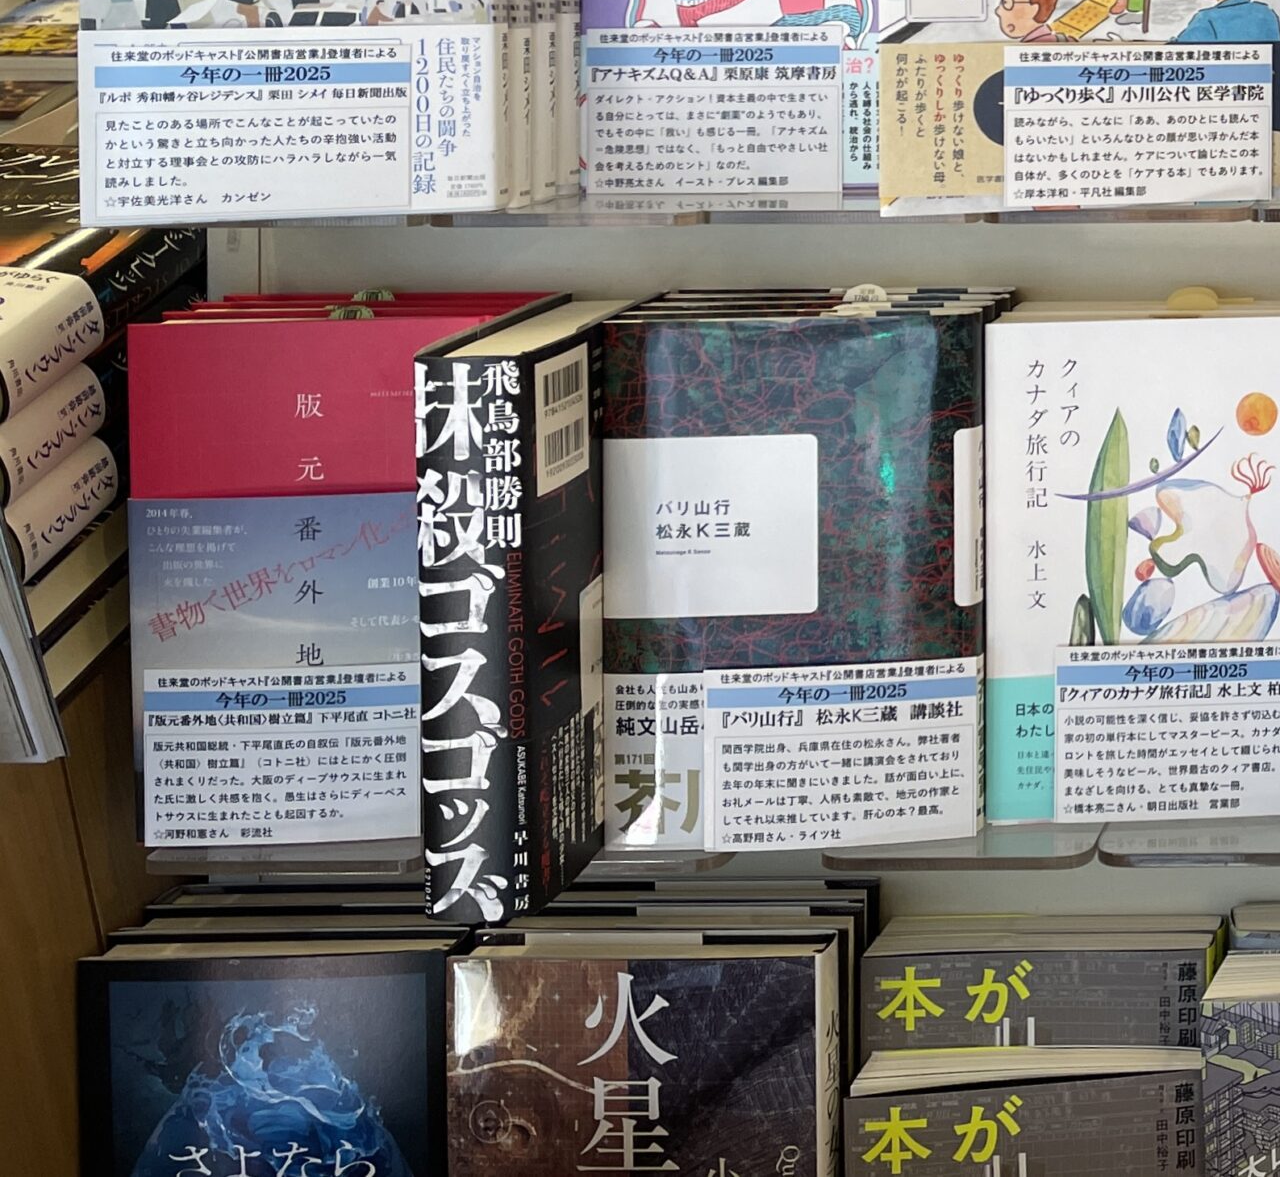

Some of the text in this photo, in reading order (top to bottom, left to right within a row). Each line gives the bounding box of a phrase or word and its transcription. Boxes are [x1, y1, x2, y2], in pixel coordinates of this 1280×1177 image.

[653, 48, 773, 63] 今年の一冊2025
[180, 66, 331, 84] 今年の一冊2025
[1078, 67, 1205, 84] 今年の一冊2025
[436, 38, 457, 157] 住民たちの闘争
[896, 53, 909, 136] 何かが起こる！
[914, 53, 927, 138] ふたりが歩くと
[1014, 85, 1264, 105] 『ゆっくり歩く』 小川公代 医学書院
[105, 114, 397, 131] 見たことのある場所でこんなことが起こっていたの
[933, 53, 946, 188] ゆっくりしか歩けない母。
[952, 53, 965, 178] ゆっくり歩けない娘と、
[1014, 113, 1259, 129] 読みながら、こんなに「ああ、あのひとにも読んで
[105, 133, 397, 150] かという驚きと立ち向かった人たちの辛抱強い活動
[1014, 131, 1259, 146] もらいたい」といろんなひとの顔が思い浮かんだ本
[105, 151, 397, 169] と対立する理事会との攻防にハラハラしながら一気
[1014, 149, 1259, 164] はないかもしれません。ケアについて論じたこの本
[105, 177, 188, 188] 読みしました。
[1014, 166, 1264, 181] 自体が、多くのひとを「ケアする本」でもあります。
[1026, 359, 1048, 509] カナダ旅行記
[480, 358, 522, 550] 飛鳥部勝則
[656, 499, 731, 516] バリ山行
[294, 393, 324, 667] 版元番外地
[655, 522, 751, 539] 松永K三蔵
[1027, 540, 1048, 610] 水上文
[413, 358, 508, 923] 抹殺ゴスゴッズ
[1125, 664, 1247, 681] 今年の一冊2025
[216, 691, 346, 708] 今年の一冊2025
[778, 683, 907, 704] 今年の一冊2025
[1218, 683, 1262, 698] 水上文
[319, 709, 368, 724] 下平尾直
[373, 708, 417, 722] コトニ社
[722, 702, 963, 730] 『バリ山行』 松永K三蔵 講談社
[722, 733, 961, 755] 関西学院出身、兵庫県在住の松永さん。弊社著者
[722, 751, 961, 773] も関学出身の方がいて一緒に講演会をされており
[722, 769, 965, 790] 去年の年末に聞きにいきました。話が面白い上に、
[876, 959, 1034, 1031] 本が
[1177, 961, 1198, 1048] 藤原印刷
[576, 971, 680, 1173] 火星
[861, 1094, 1024, 1174] 本が
[1174, 1082, 1196, 1171] 藤原印刷
